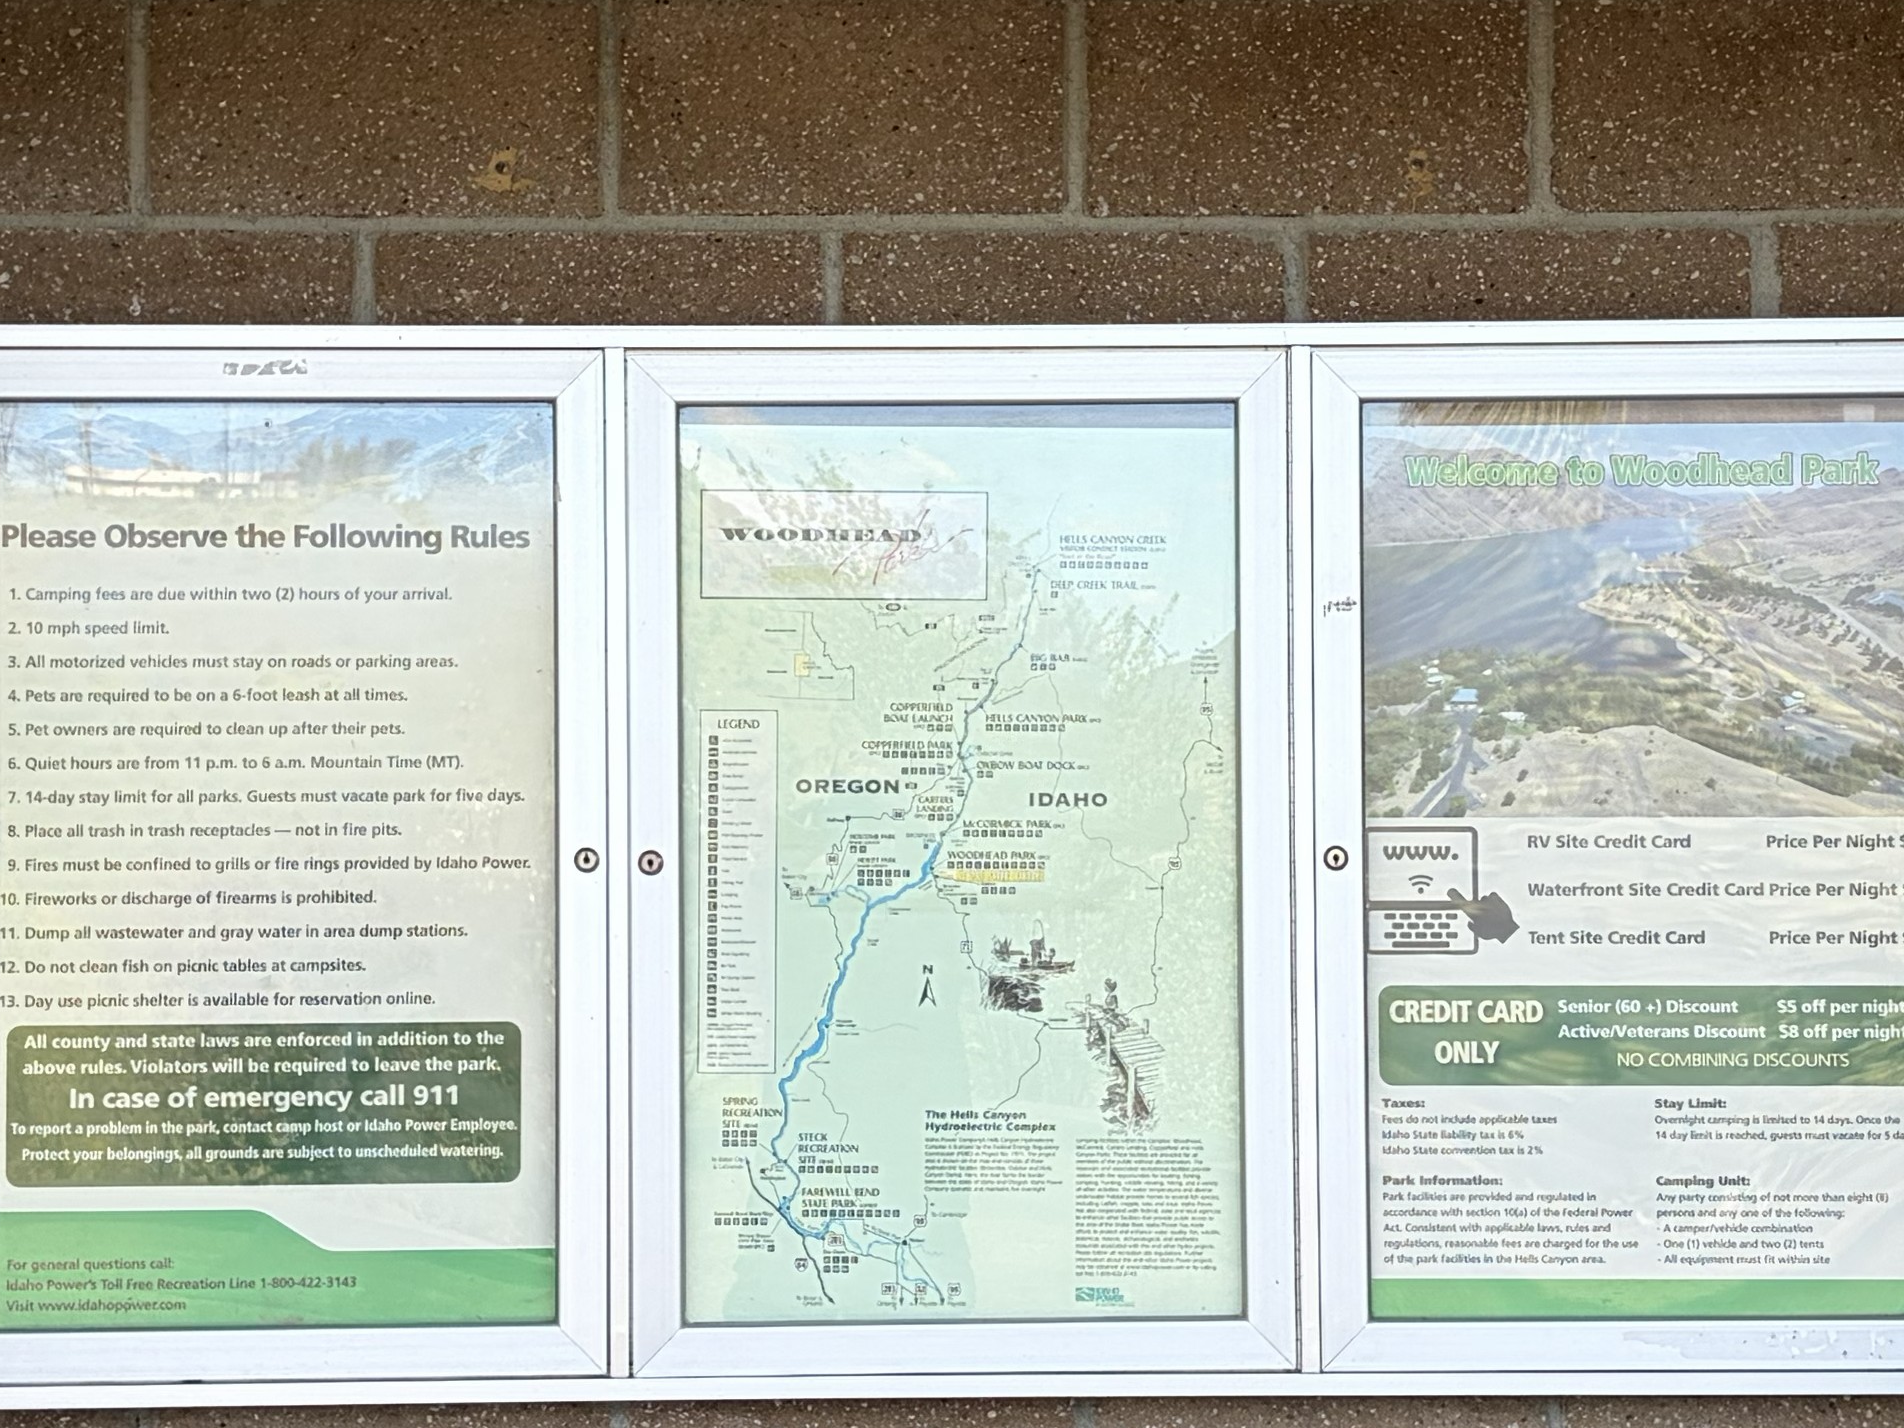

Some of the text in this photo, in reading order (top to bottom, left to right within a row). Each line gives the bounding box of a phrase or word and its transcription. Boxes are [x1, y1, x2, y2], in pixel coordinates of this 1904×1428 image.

[1404, 452, 1882, 488] Welcome to Woodhead Park
[1, 523, 530, 555] Please Observe the Following Rules
[720, 528, 922, 542] WOODHEAD
[9, 586, 452, 604] 1. Camping fees are due within two (2) hours of your arrival.
[8, 621, 170, 637] 2. 10 mph speed limit.
[8, 688, 408, 705] 4. Pets are required to be on a 6-foot leash at all times.
[717, 719, 760, 730] LEGEND
[8, 755, 464, 772] 6. Quiet hours are from 11 p.m. to 6 a.m. Mountain Time (MT).
[796, 779, 900, 794] OREGON
[1028, 792, 1108, 808] IDAHO
[1527, 835, 1551, 848] RV
[1556, 834, 1589, 848] Site
[1594, 834, 1647, 848] Credit
[1651, 834, 1691, 848] Card
[1766, 834, 1808, 848] Price
[1813, 835, 1842, 848] Per
[1846, 834, 1895, 852] Night
[1382, 844, 1460, 861] www.
[0, 890, 377, 908] 10. Fireworks or discharge of firearms is prohibited.
[923, 965, 934, 974] N
[1388, 1000, 1544, 1023] CREDIT CARD
[1557, 999, 1612, 1013] Senior
[1615, 999, 1641, 1015] (60
[1666, 998, 1739, 1013] Discount
[1777, 999, 1797, 1016] $5
[1801, 999, 1826, 1013] off
[1830, 1003, 1859, 1016] per
[1558, 1024, 1690, 1043] Active/Veterans
[1694, 1023, 1766, 1038] Discount
[1779, 1023, 1799, 1041] $8
[1803, 1023, 1828, 1039] off
[1831, 1028, 1861, 1042] per
[1434, 1041, 1500, 1065] ONLY
[1617, 1052, 1850, 1068] NO COMBINING DISCOUNTS
[70, 1083, 458, 1113] In case of emergency call 911
[1381, 1098, 1425, 1108] Taxes:
[1654, 1098, 1727, 1111] Stay Limit:
[925, 1110, 1027, 1122] The Hells Canyon
[925, 1122, 1057, 1133] Hydroelectric Complex
[1382, 1174, 1503, 1185] Park Information:
[1656, 1175, 1751, 1188] Camping Unit:
[6, 1279, 43, 1292] Idaho
[100, 1278, 123, 1290] Toll
[126, 1278, 154, 1291] Free
[157, 1277, 226, 1290] Recreation
[229, 1277, 256, 1289] Line
[6, 1300, 34, 1312] Visit
